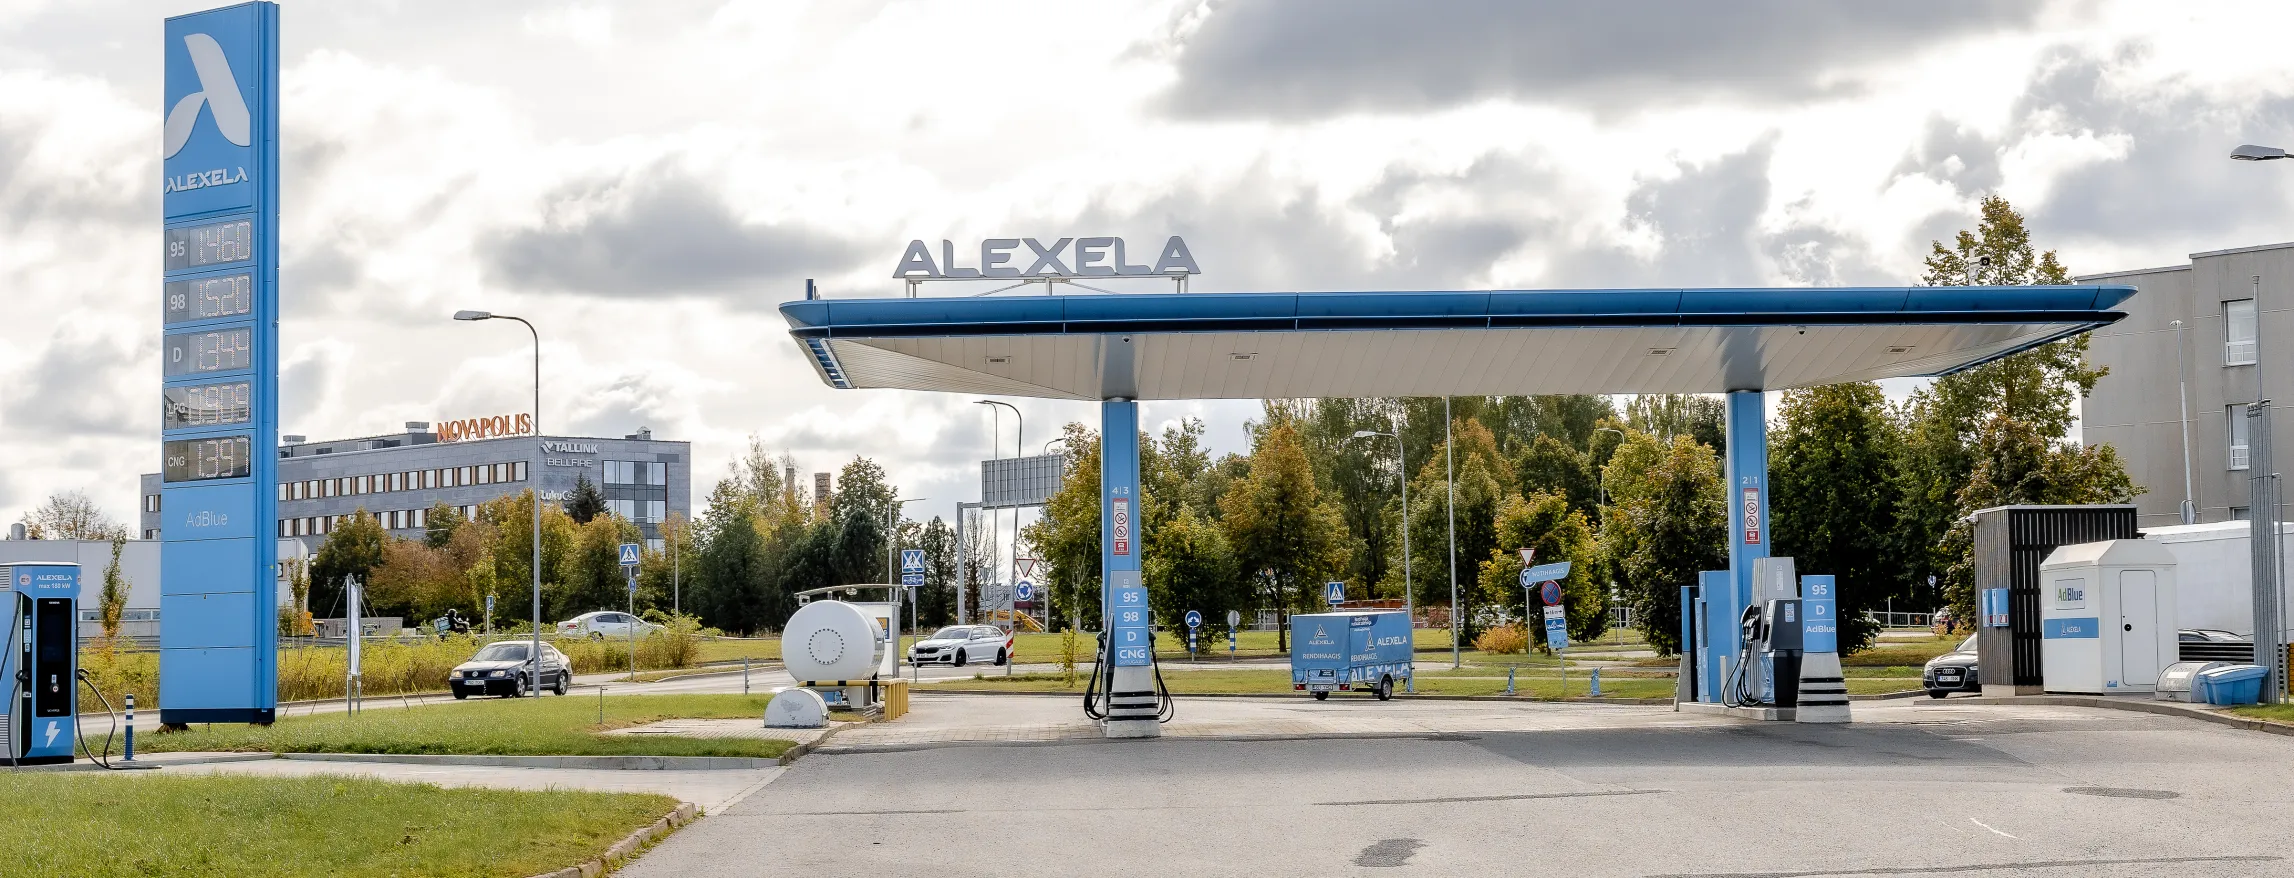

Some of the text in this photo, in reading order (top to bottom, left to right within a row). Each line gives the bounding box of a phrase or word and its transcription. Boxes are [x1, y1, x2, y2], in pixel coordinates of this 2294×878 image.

[165, 167, 249, 194] ALEXELA
[170, 240, 185, 258] 95
[892, 235, 1201, 278] ALEXELA
[170, 293, 186, 311] 98
[173, 346, 182, 363] D
[168, 402, 186, 414] LPG
[437, 412, 531, 443] NOVAPOLIS
[555, 442, 599, 454] TALLINK
[168, 456, 185, 467] CNG
[547, 457, 593, 468] BELLFIRE
[185, 510, 228, 528] AdBlue
[1812, 584, 1828, 596] 95
[2057, 587, 2083, 601] AdBlue
[1123, 591, 1139, 603] 95
[1123, 611, 1139, 622] 98
[1815, 605, 1825, 616] D
[1805, 625, 1836, 633] AdBlue
[1127, 631, 1137, 642] D
[1376, 635, 1408, 647] ALEXELA
[1119, 649, 1146, 659] CNG
